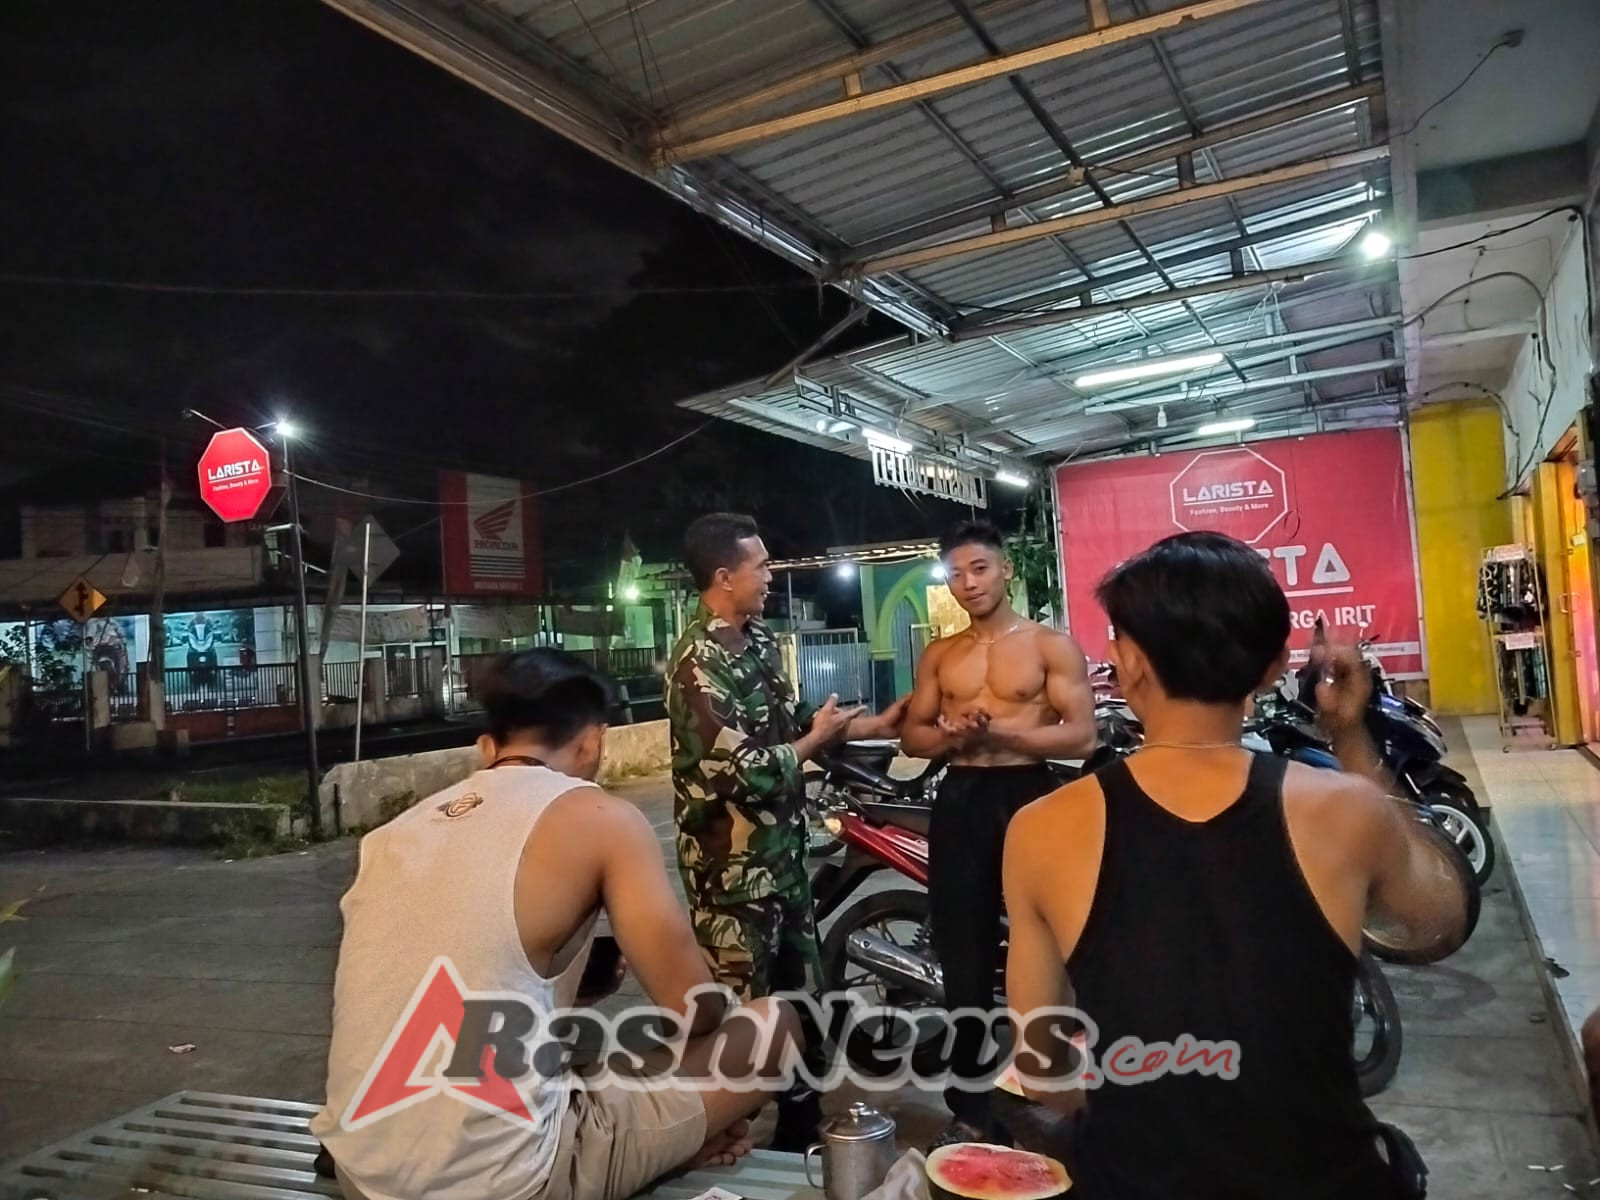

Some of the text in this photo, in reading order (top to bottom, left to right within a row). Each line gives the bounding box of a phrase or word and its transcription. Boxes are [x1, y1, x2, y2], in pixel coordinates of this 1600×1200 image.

[207, 459, 260, 480] LARISTA
[1183, 479, 1273, 502] LARISTA
[1335, 604, 1377, 626] IRIT
